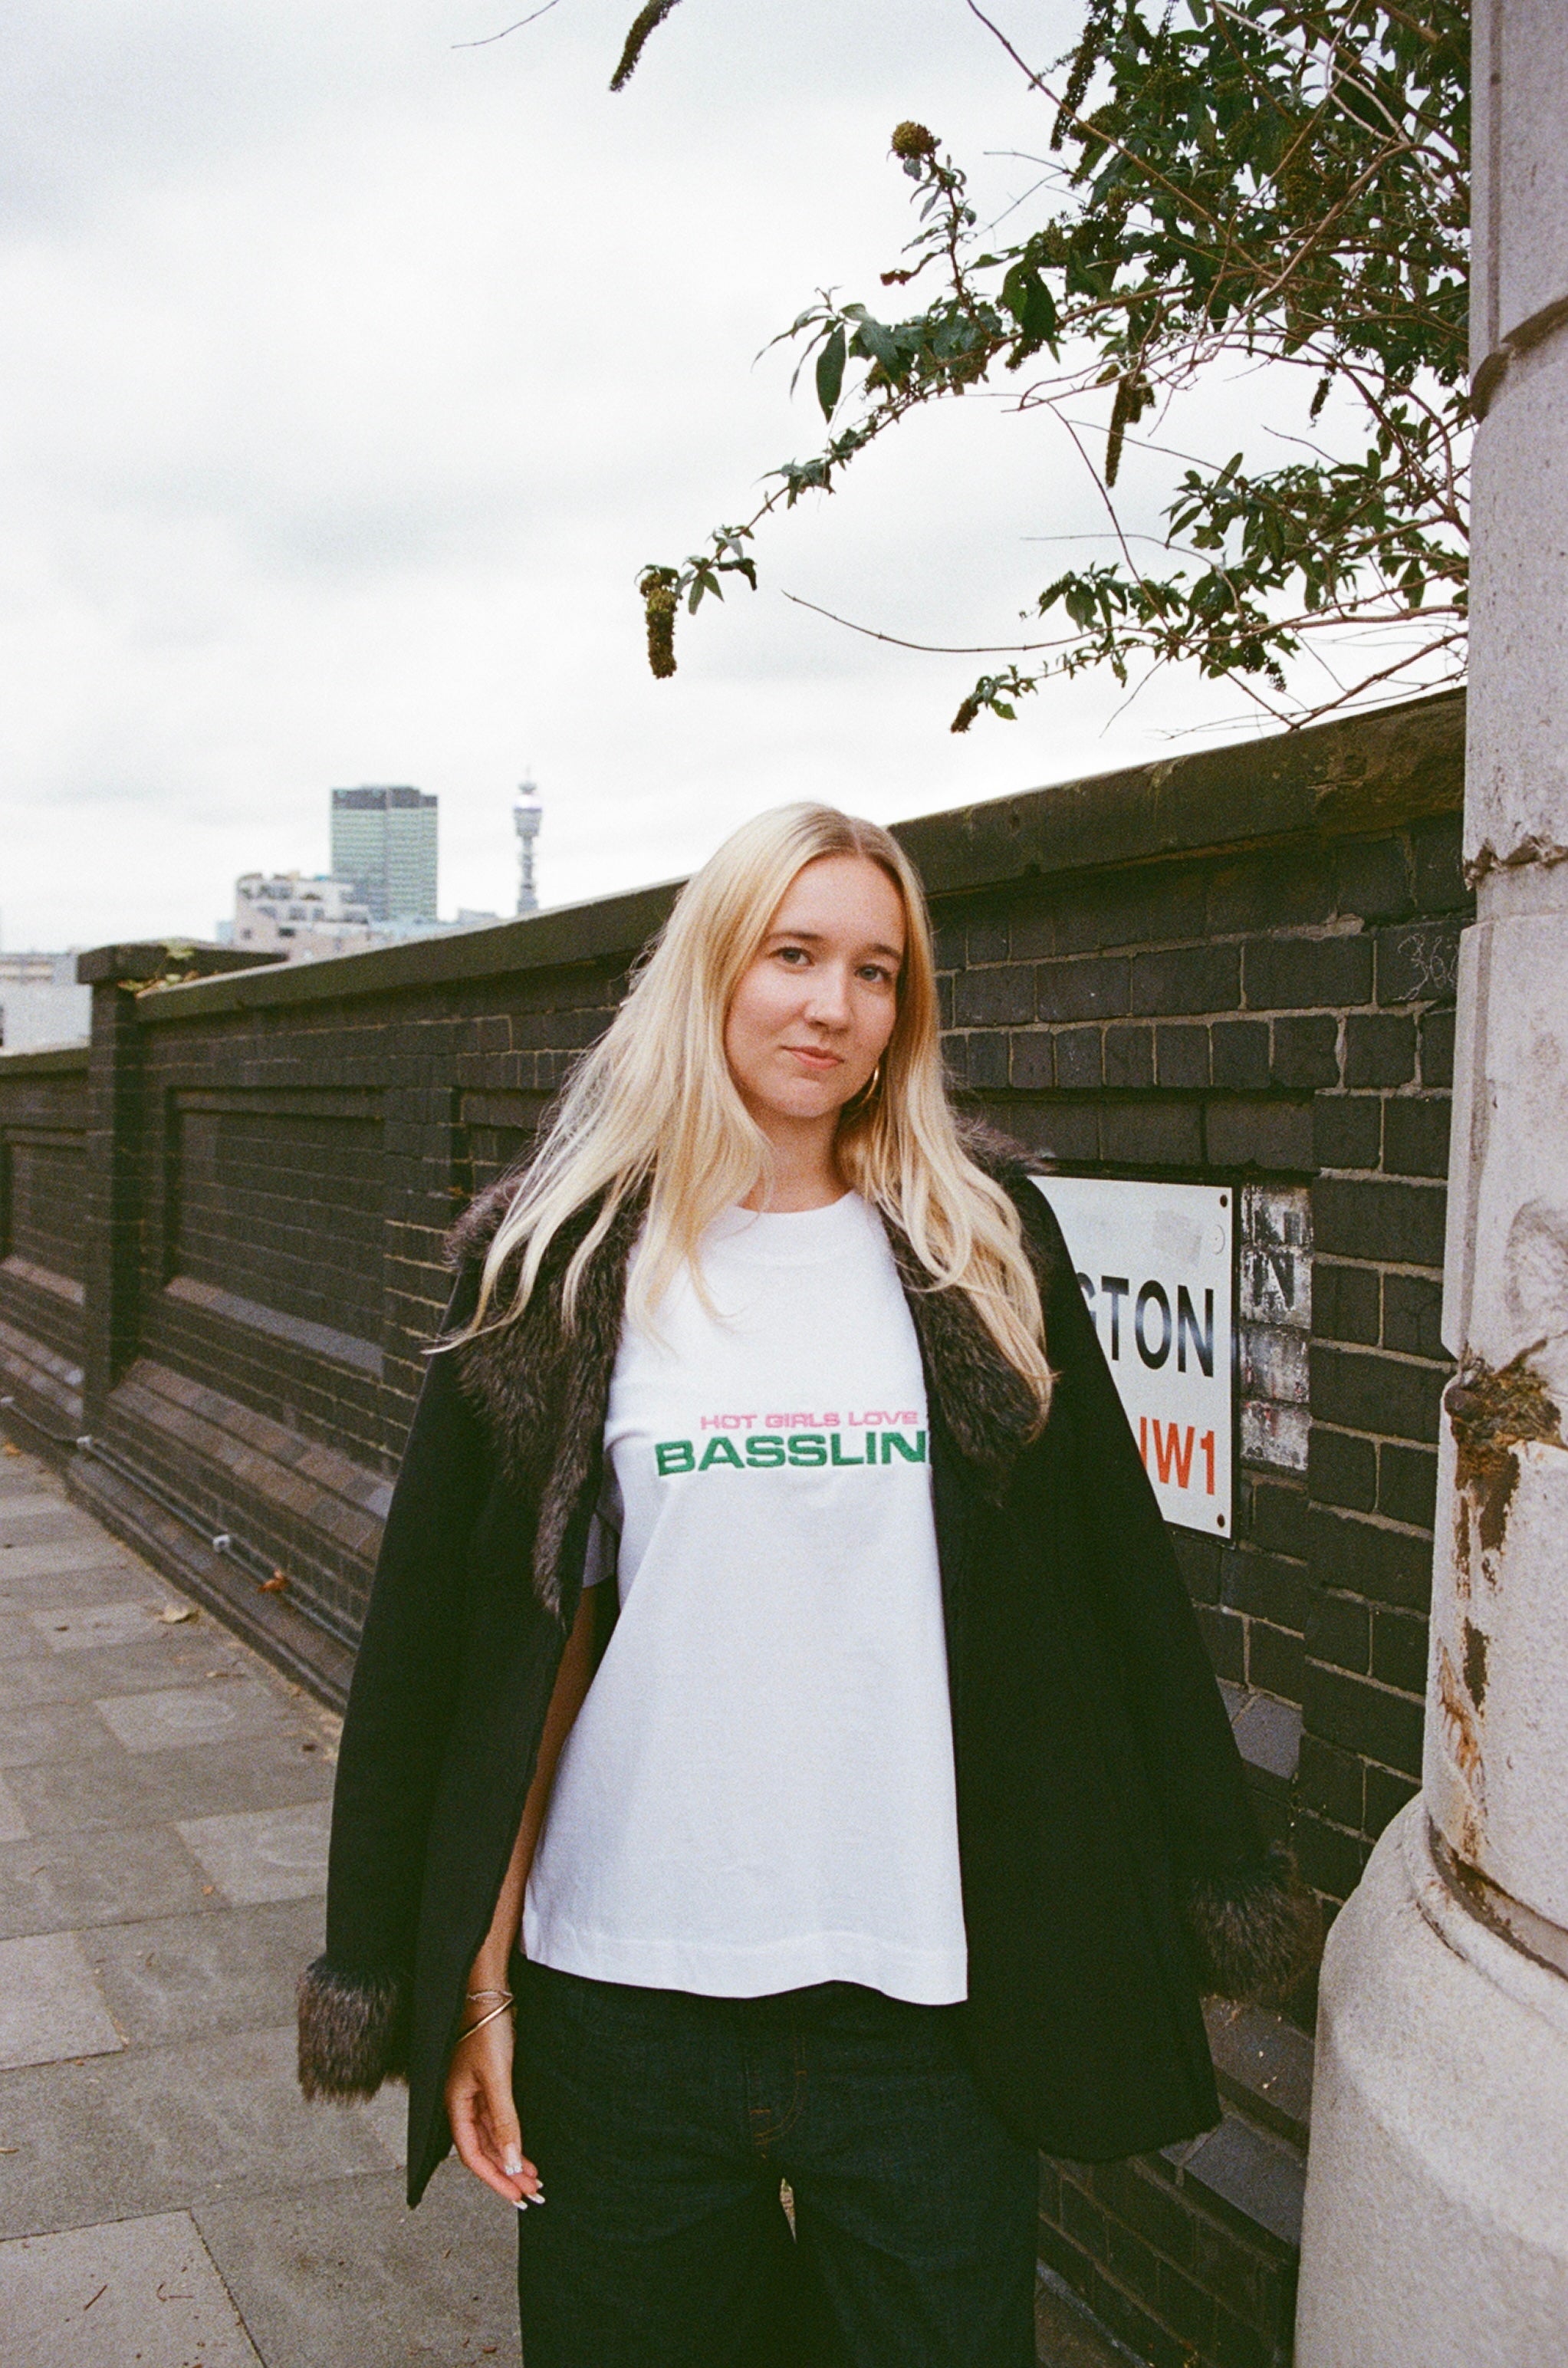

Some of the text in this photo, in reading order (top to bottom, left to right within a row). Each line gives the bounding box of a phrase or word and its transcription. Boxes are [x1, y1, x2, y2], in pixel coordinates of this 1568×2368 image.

[701, 1411, 919, 1429] HOT GIRLS LOVE
[655, 1431, 926, 1476] BASSLIN
